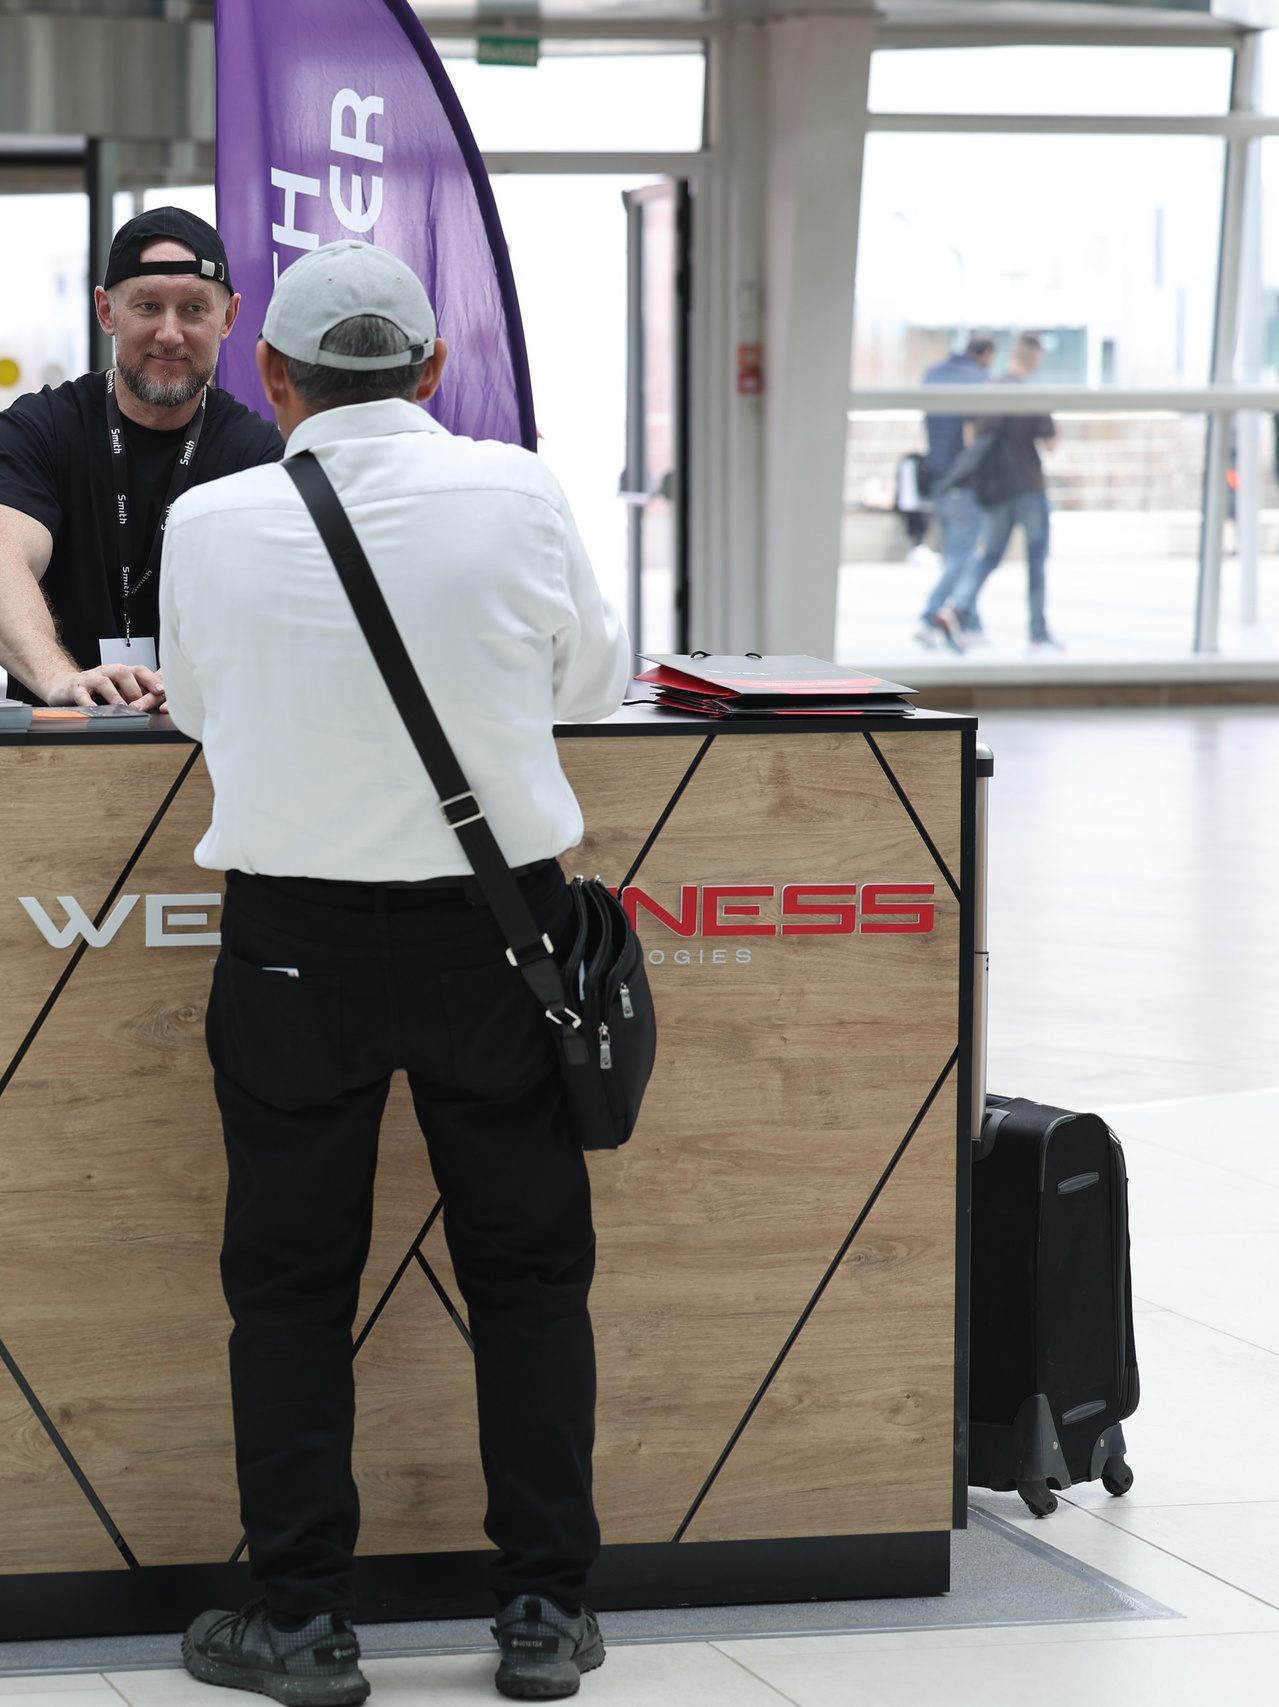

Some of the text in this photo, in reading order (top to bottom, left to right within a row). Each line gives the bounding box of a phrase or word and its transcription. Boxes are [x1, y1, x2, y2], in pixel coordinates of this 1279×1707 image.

[329, 87, 384, 233] ER
[111, 428, 122, 454] Smith
[180, 440, 195, 466] Smith
[117, 494, 128, 525] Smith
[122, 566, 130, 596] Smith
